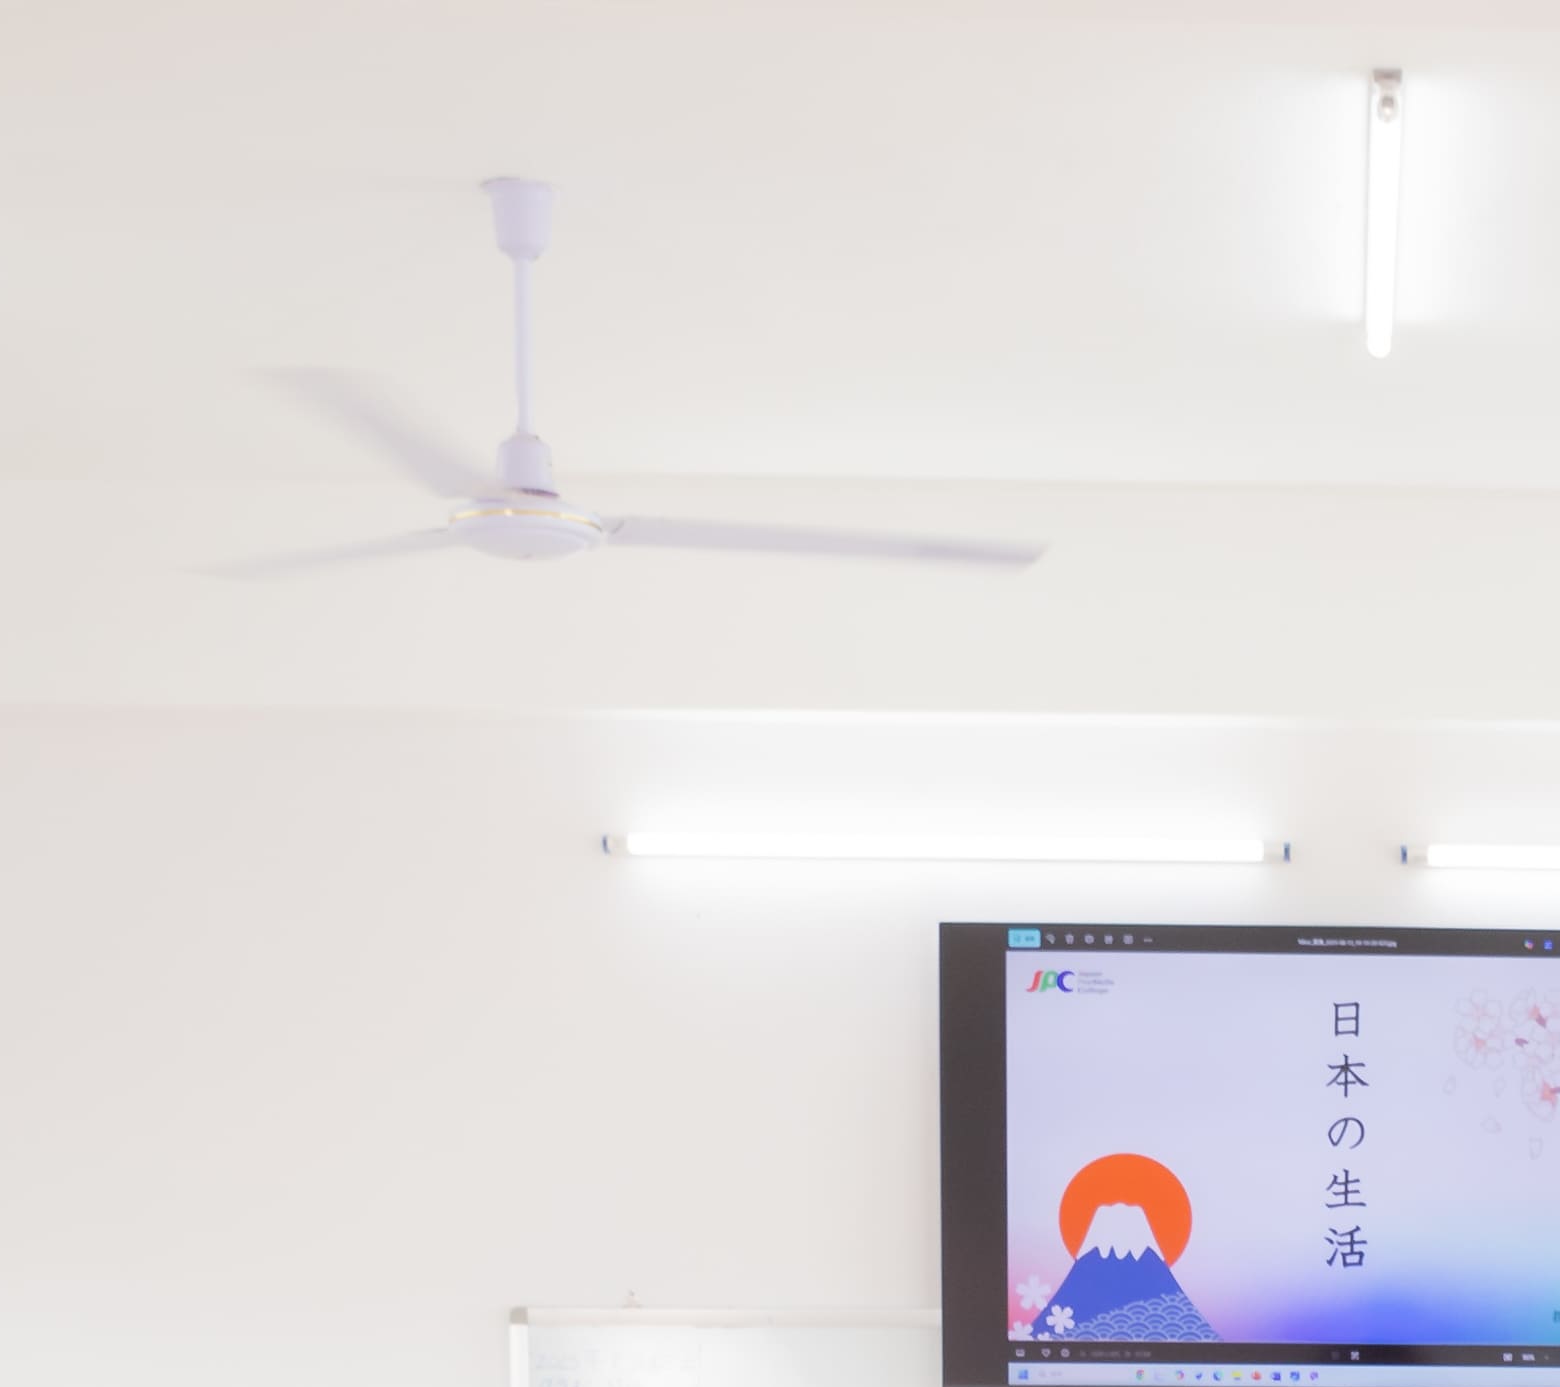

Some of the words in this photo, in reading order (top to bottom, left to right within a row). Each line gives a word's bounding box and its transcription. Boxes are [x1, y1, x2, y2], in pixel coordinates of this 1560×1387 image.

[1026, 969, 1075, 993] JPC
[1324, 1000, 1369, 1270] 日本の生活
